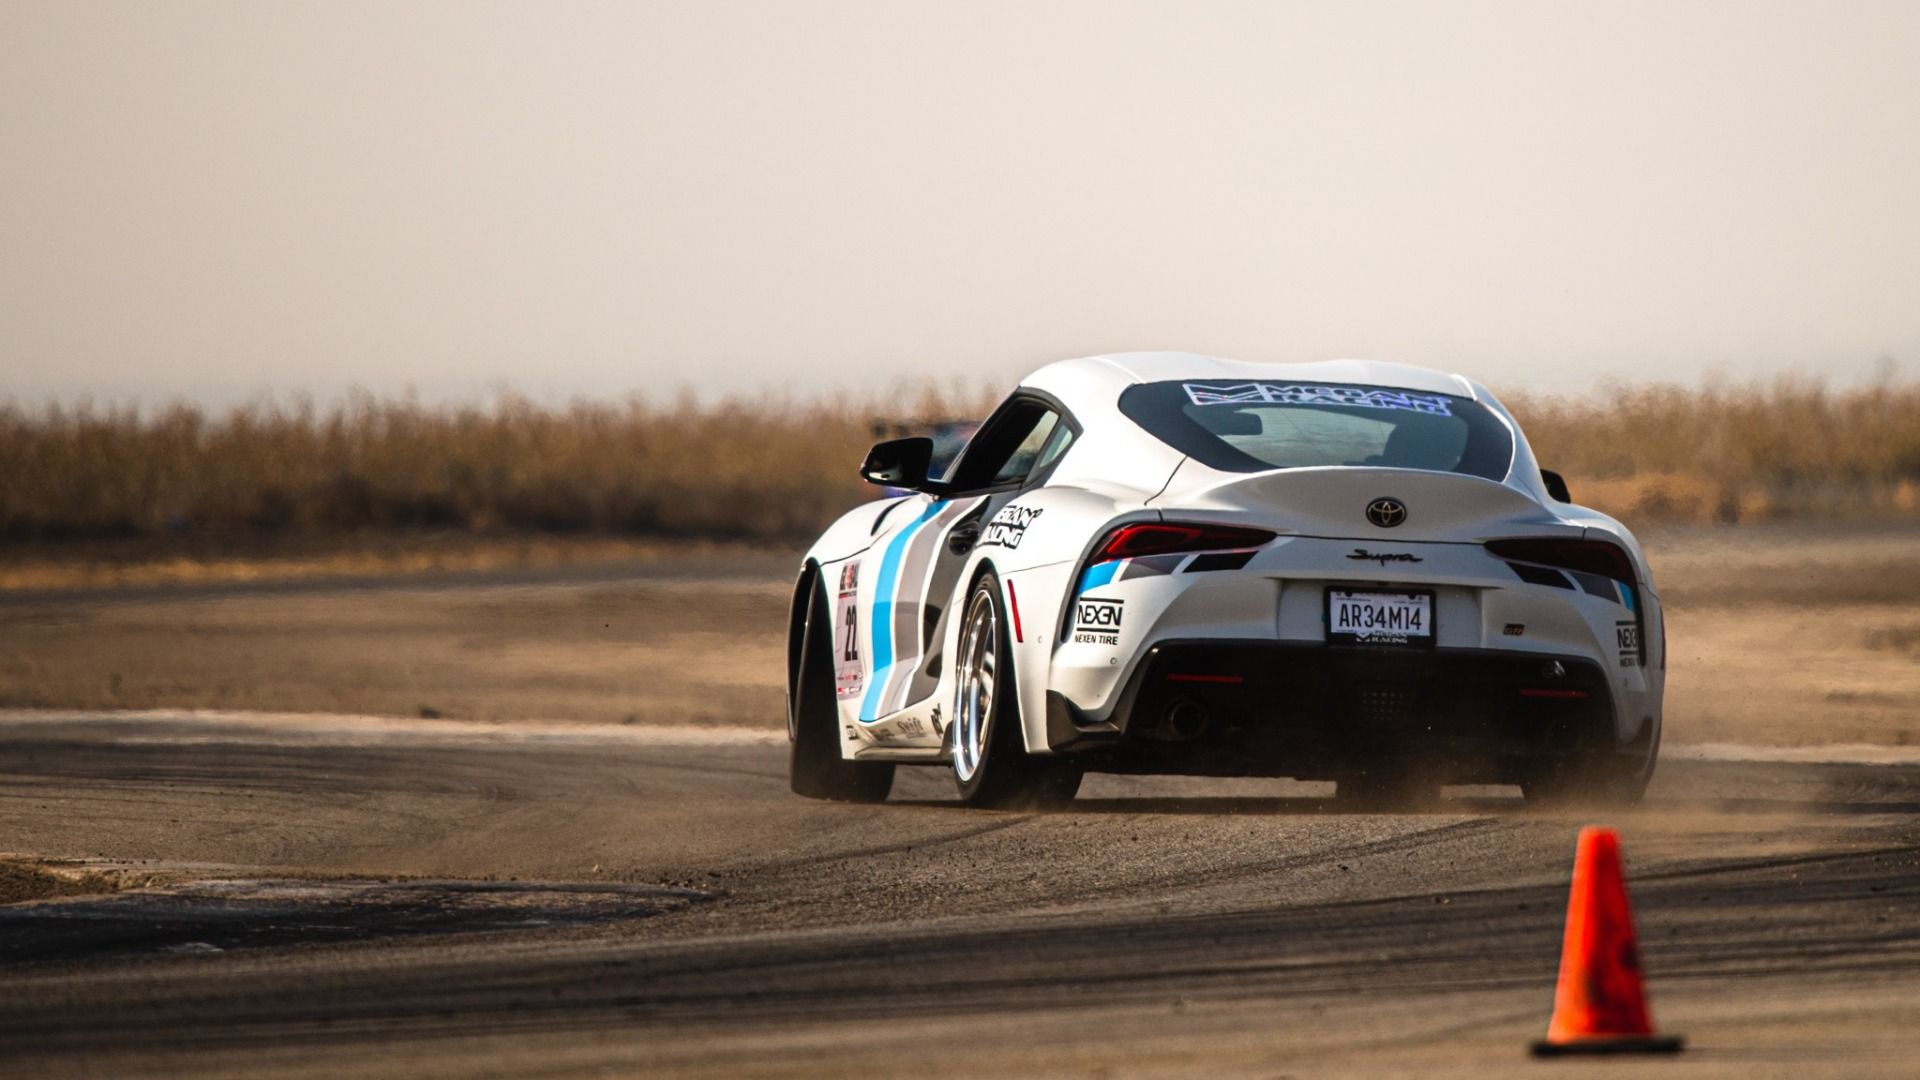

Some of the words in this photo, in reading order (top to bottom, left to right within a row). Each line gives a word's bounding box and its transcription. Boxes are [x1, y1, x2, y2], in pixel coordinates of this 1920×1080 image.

[1346, 549, 1423, 567] Supra
[1077, 604, 1123, 627] NEXEN
[1338, 603, 1423, 631] AR34M14
[844, 604, 859, 662] 22
[1075, 633, 1097, 643] NEXEN
[1099, 635, 1118, 645] TIRE
